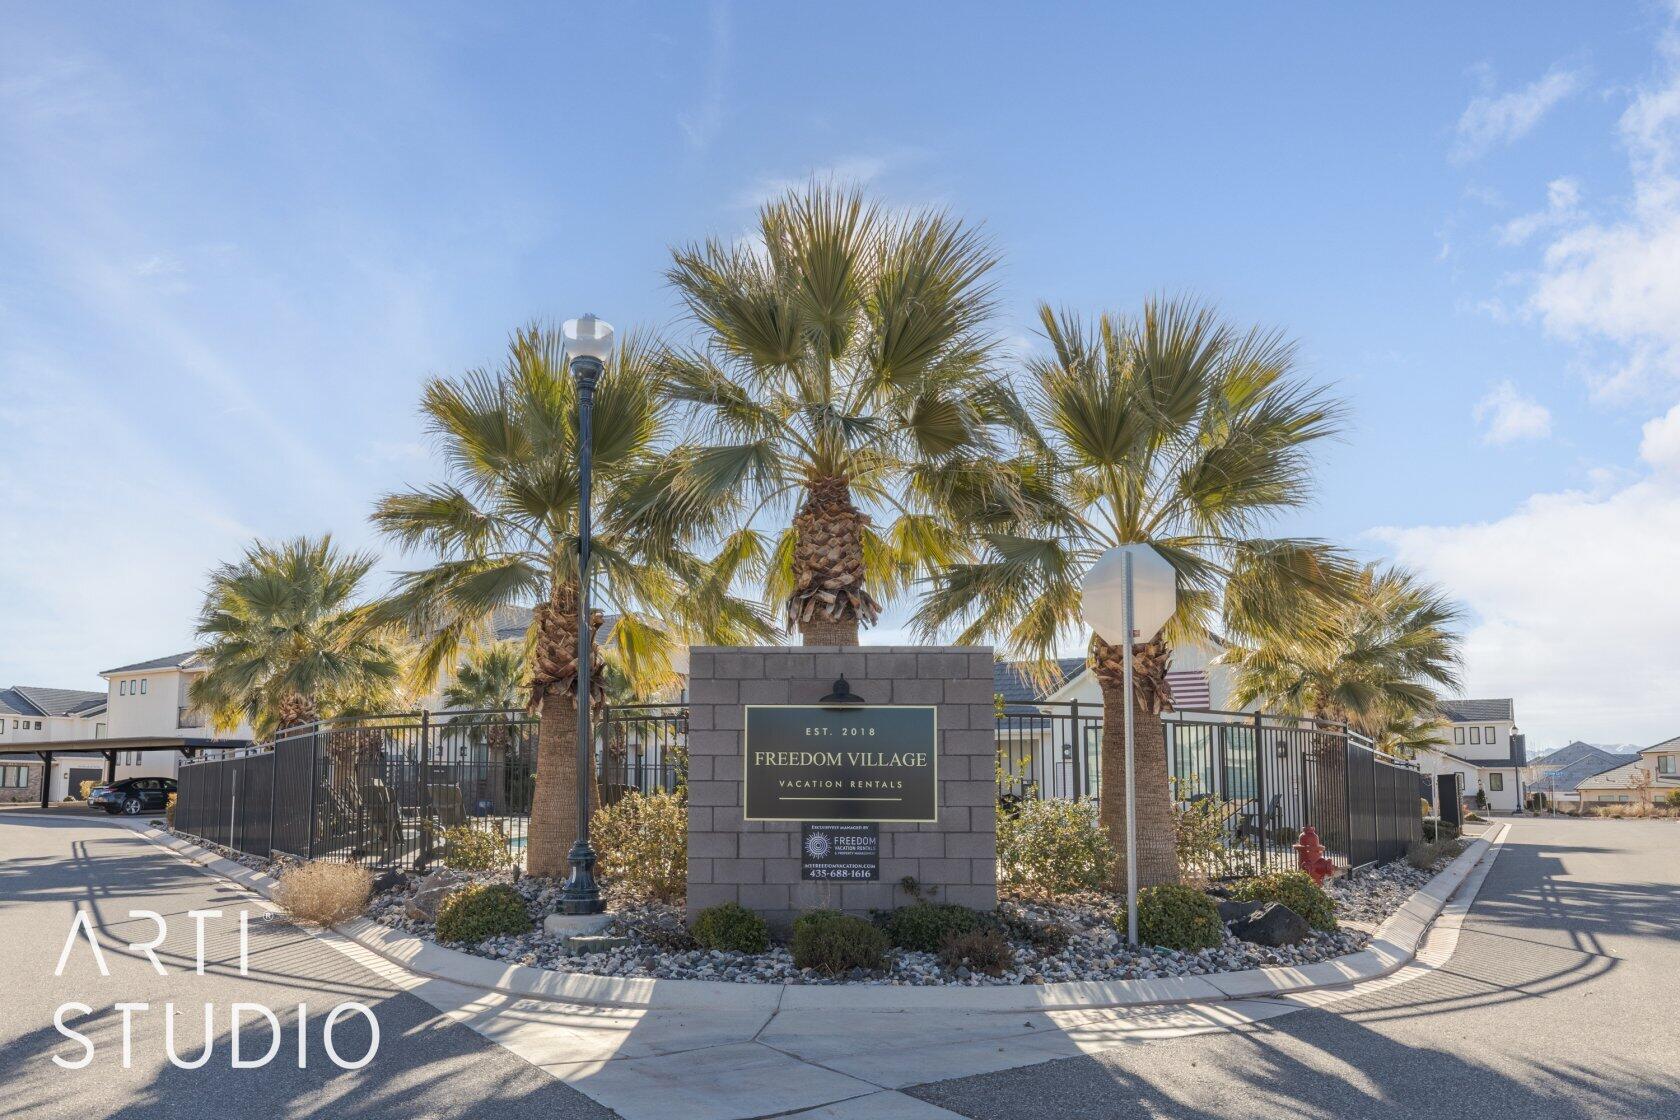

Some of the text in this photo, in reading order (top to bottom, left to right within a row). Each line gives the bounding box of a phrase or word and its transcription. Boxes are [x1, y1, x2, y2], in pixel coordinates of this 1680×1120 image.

[805, 727, 876, 736] EST. 2018
[754, 751, 928, 767] FREEDOM VILLAGE
[779, 780, 903, 789] VACATION RENTALS
[834, 836, 876, 845] FREEDOM
[809, 869, 871, 878] 435-688-1616
